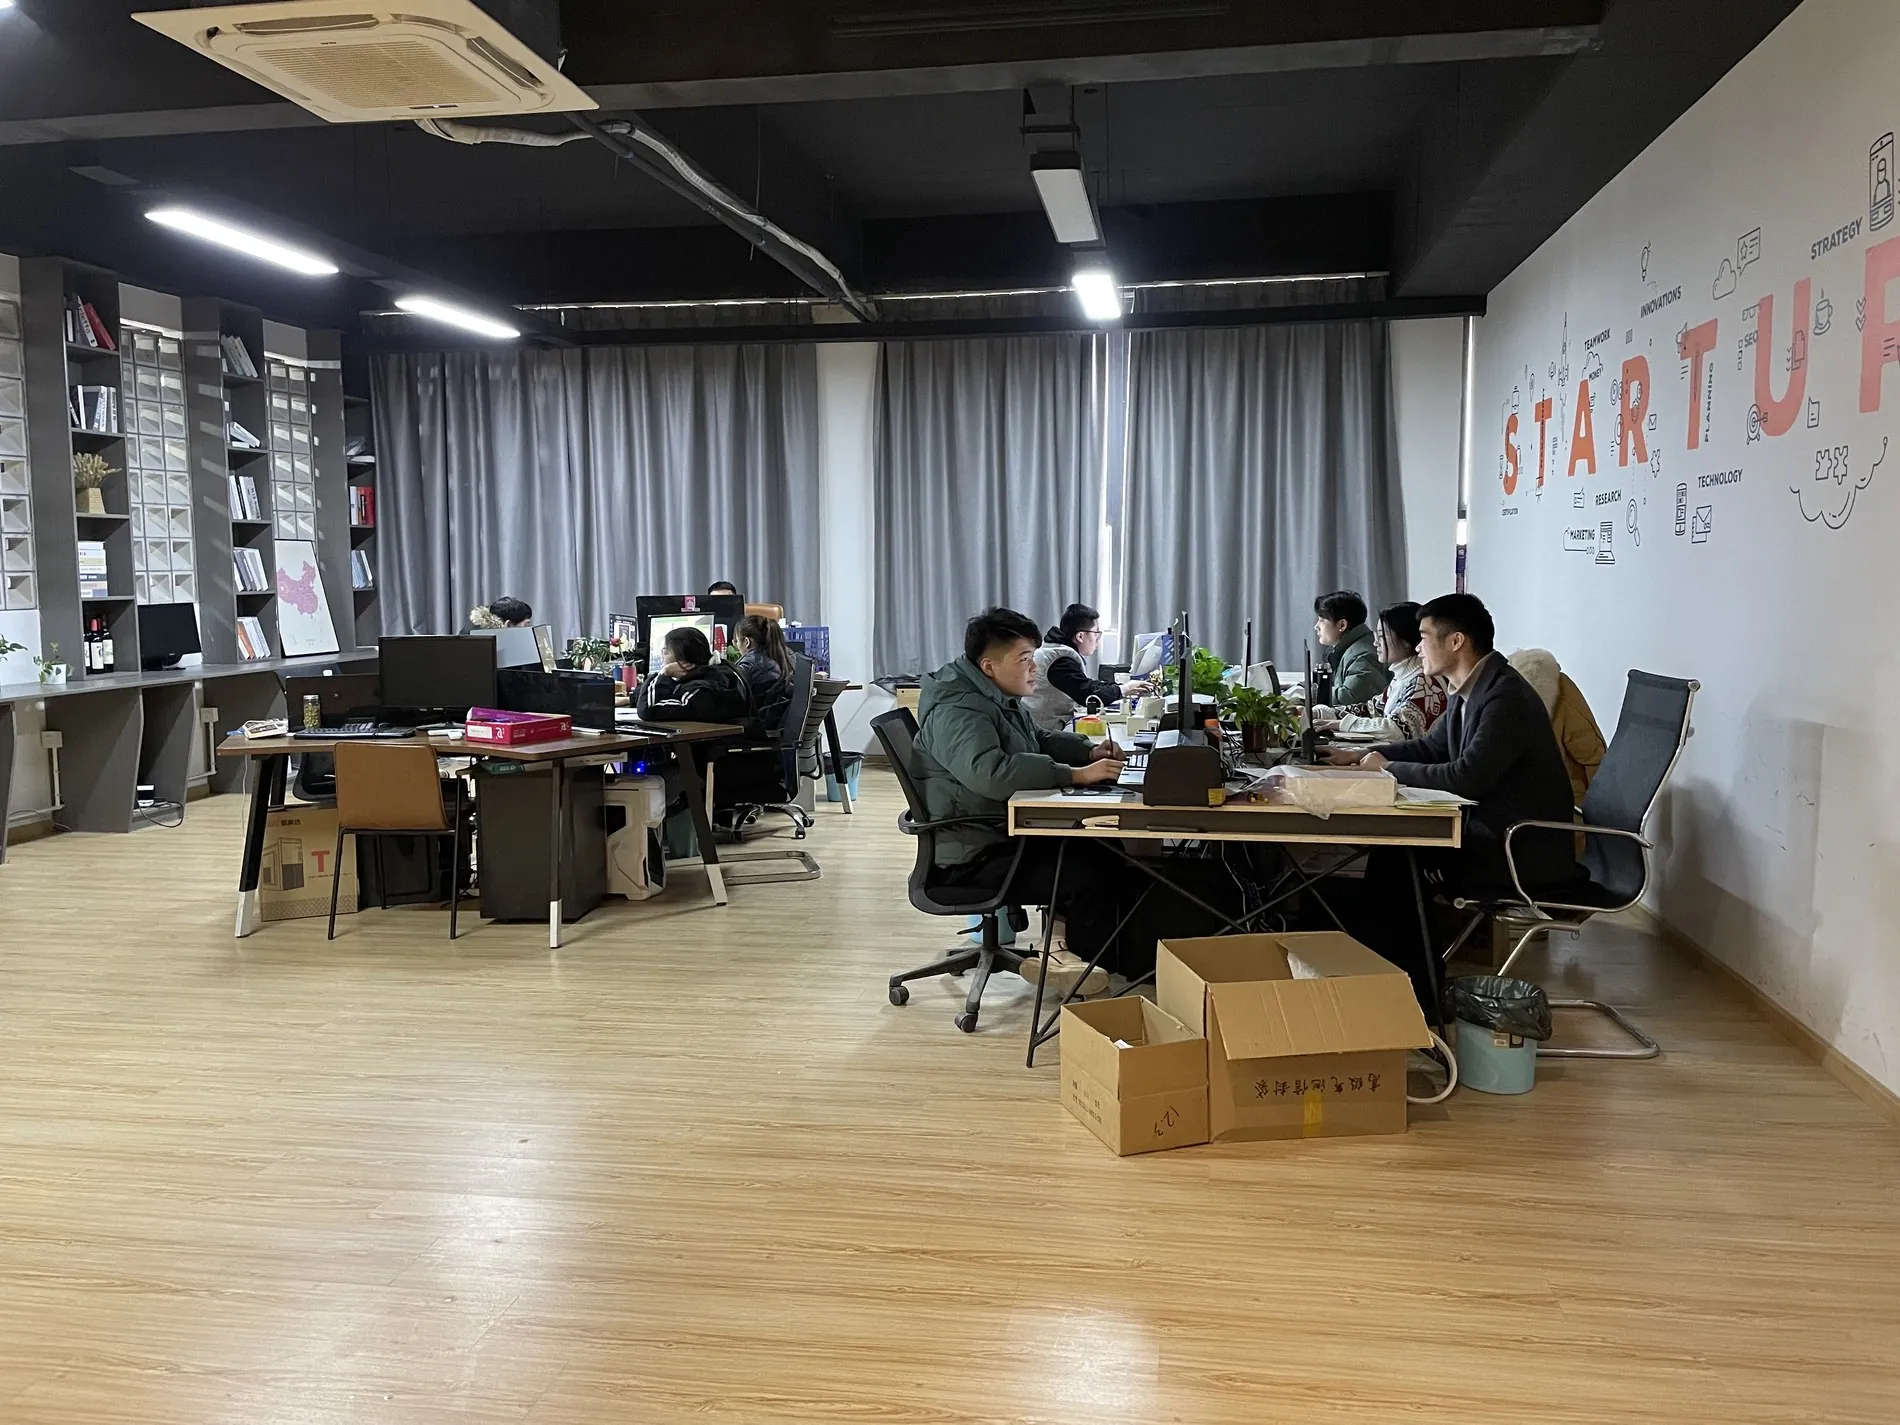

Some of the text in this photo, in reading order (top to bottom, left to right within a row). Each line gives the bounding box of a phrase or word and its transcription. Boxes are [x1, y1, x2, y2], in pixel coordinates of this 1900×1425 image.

[1811, 216, 1863, 260] STRATEGY
[1640, 285, 1682, 318] INNOVATIONS
[1584, 328, 1611, 351] TEAMWORK
[1744, 329, 1759, 348] SEO
[1704, 362, 1714, 443] PLANNING
[1698, 468, 1743, 488] TECHNOLOGY
[1595, 489, 1622, 506] RESEARCH
[1569, 528, 1596, 541] MARKETING
